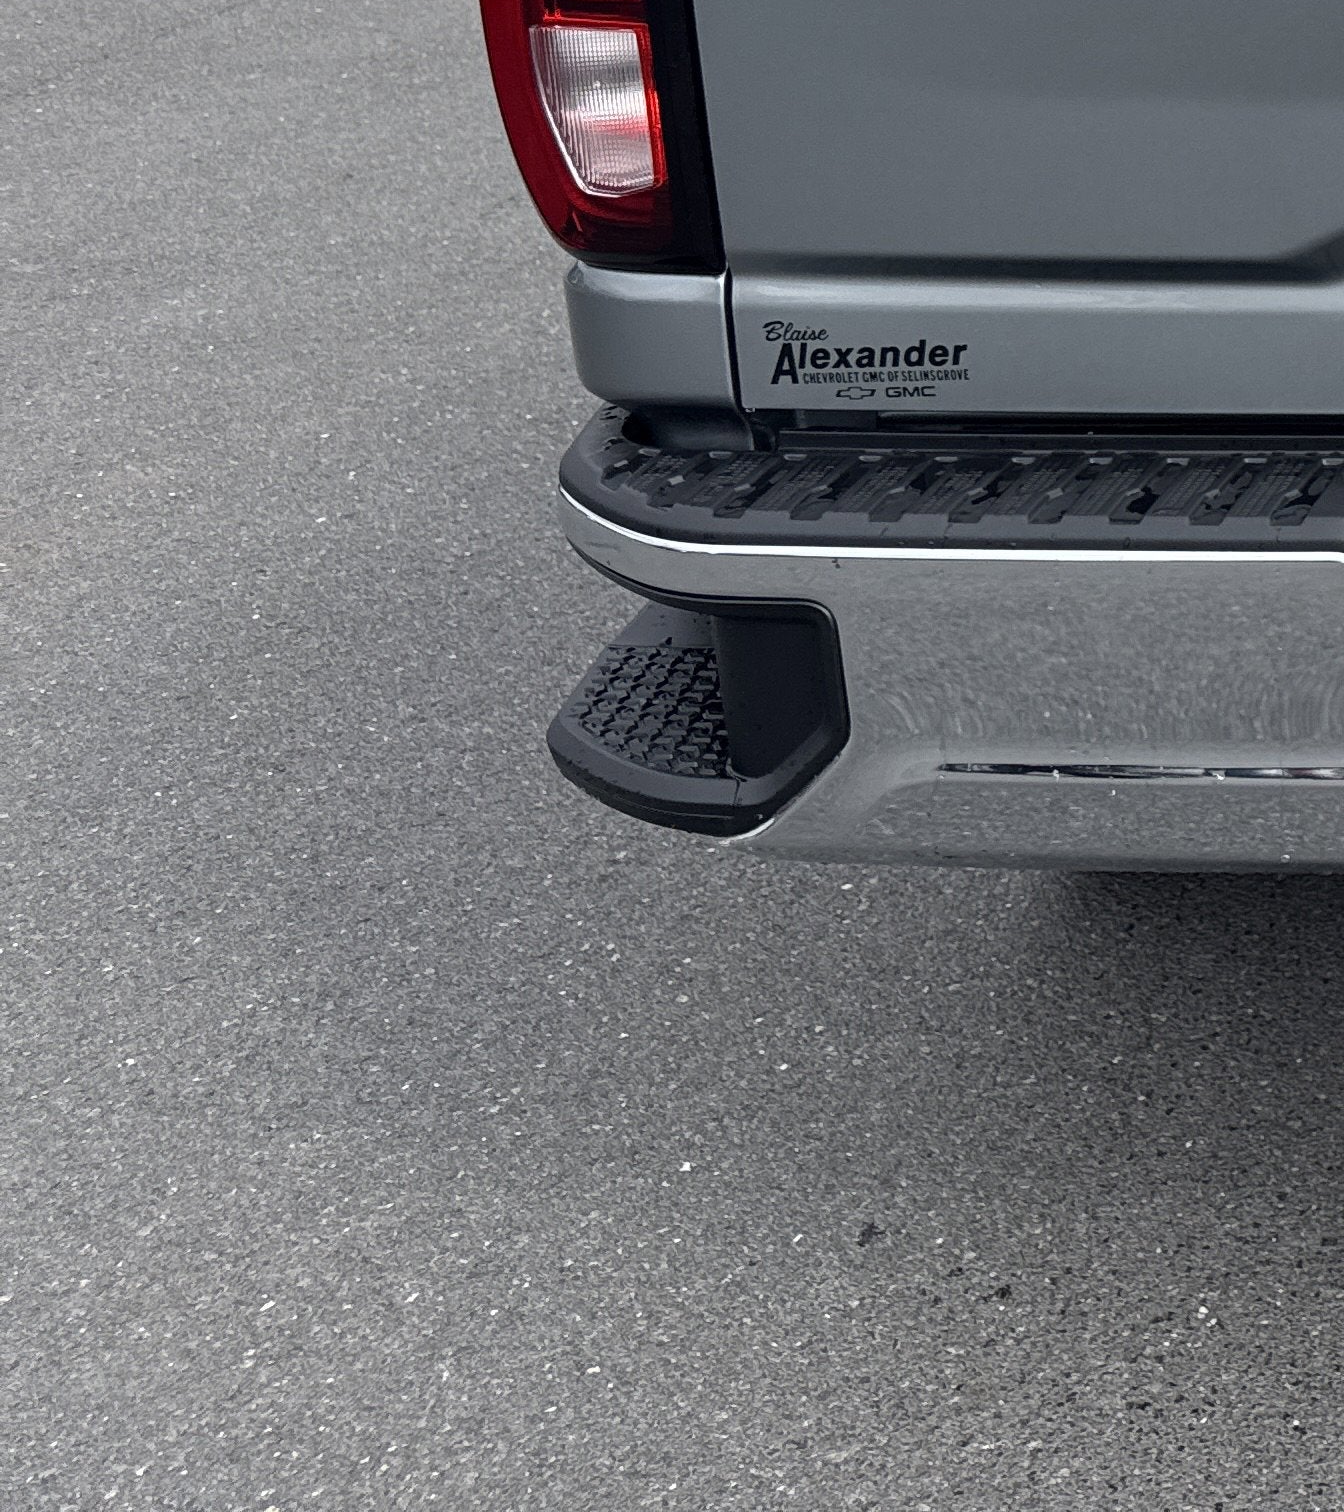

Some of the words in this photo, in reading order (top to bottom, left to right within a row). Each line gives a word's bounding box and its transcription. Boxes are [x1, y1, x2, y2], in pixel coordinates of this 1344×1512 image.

[762, 320, 830, 342] Blaise
[770, 339, 968, 385] Alexander
[802, 371, 860, 385] CHEVROLET
[862, 370, 885, 383] GMC
[887, 370, 899, 382] OF
[901, 368, 970, 382] SELINSGROVE
[885, 385, 937, 398] GMC
